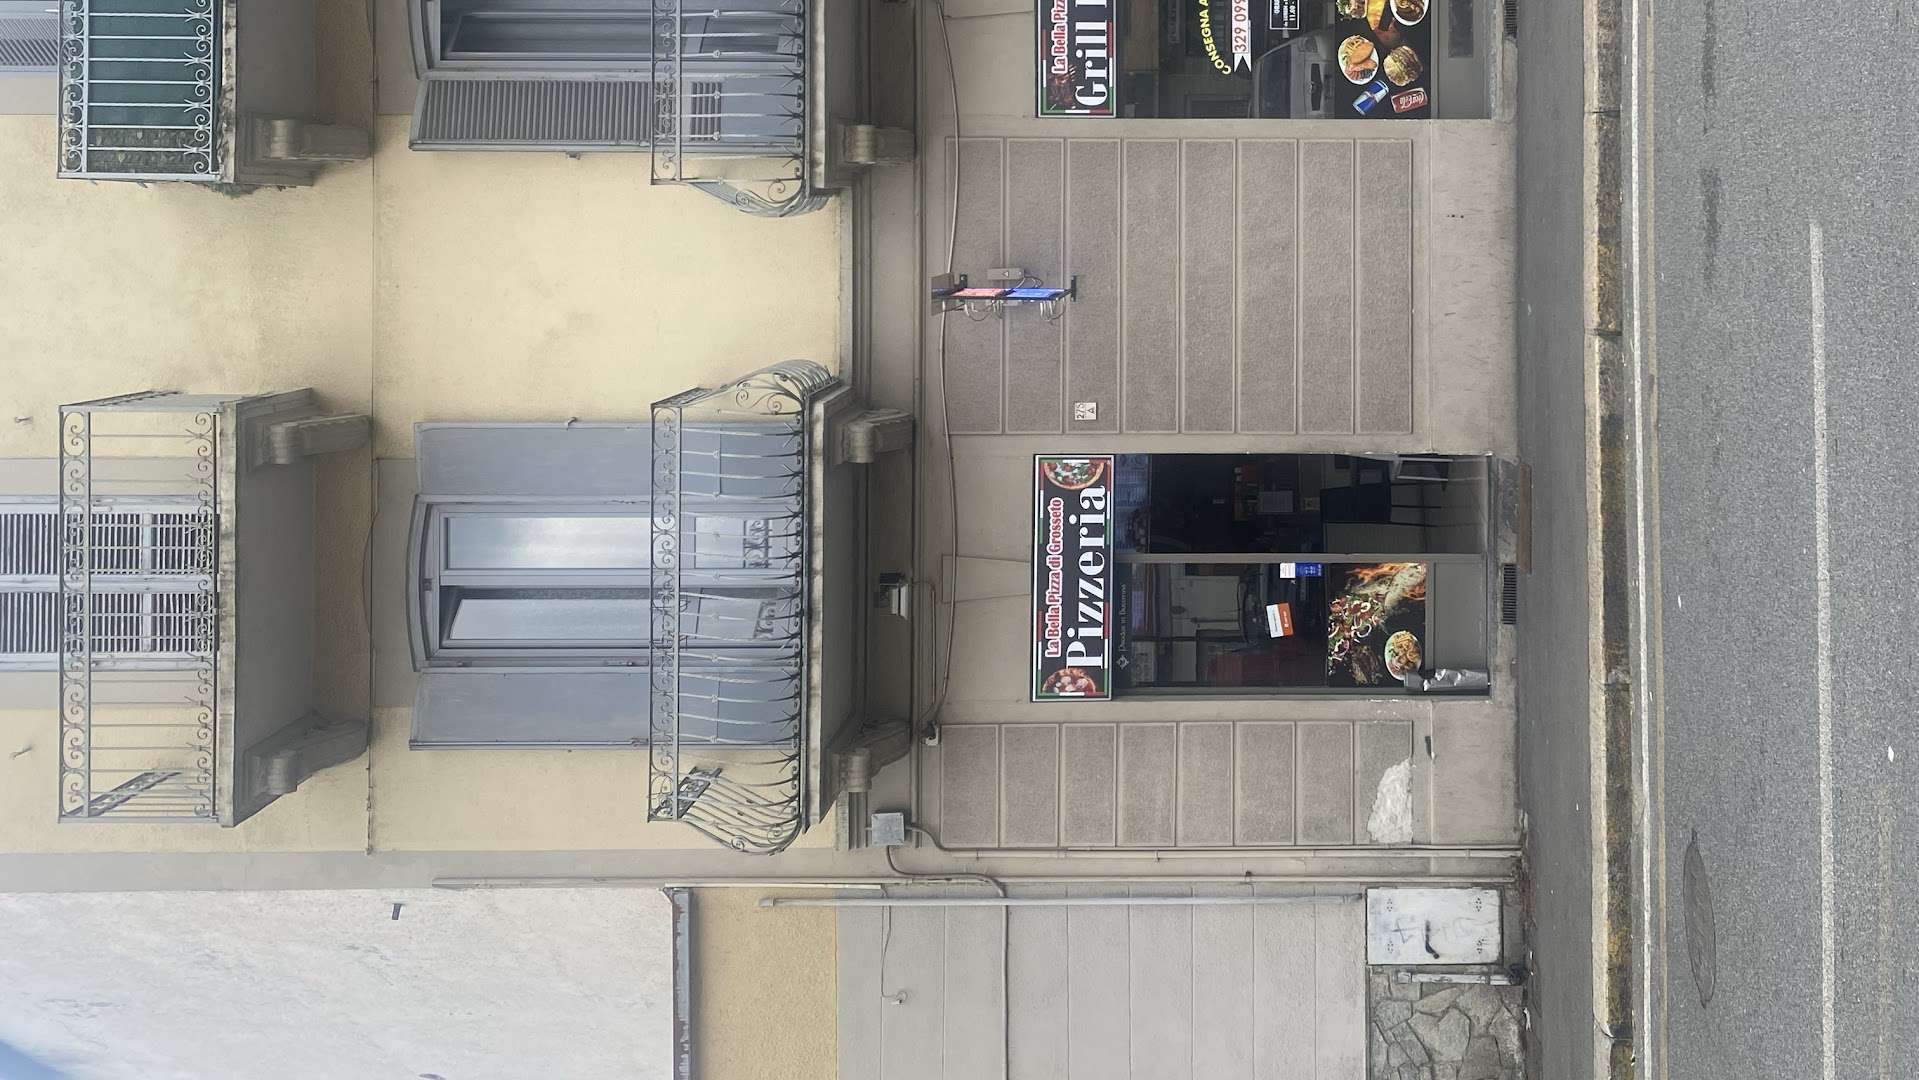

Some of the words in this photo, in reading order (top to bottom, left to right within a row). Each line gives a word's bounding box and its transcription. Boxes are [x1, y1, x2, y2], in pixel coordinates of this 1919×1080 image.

[1053, 24, 1066, 54] Bella
[1199, 10, 1232, 74] CONSEGNA
[1234, 27, 1246, 52] 329
[1053, 57, 1066, 72] La
[1075, 20, 1107, 106] Grill
[1076, 403, 1084, 418] 275
[1048, 498, 1062, 553] Grosseto
[1048, 556, 1062, 568] di
[1066, 485, 1106, 668] Pizzeria
[1047, 572, 1061, 603] Pizza
[1046, 606, 1061, 638] Bella
[1046, 640, 1060, 656] La
